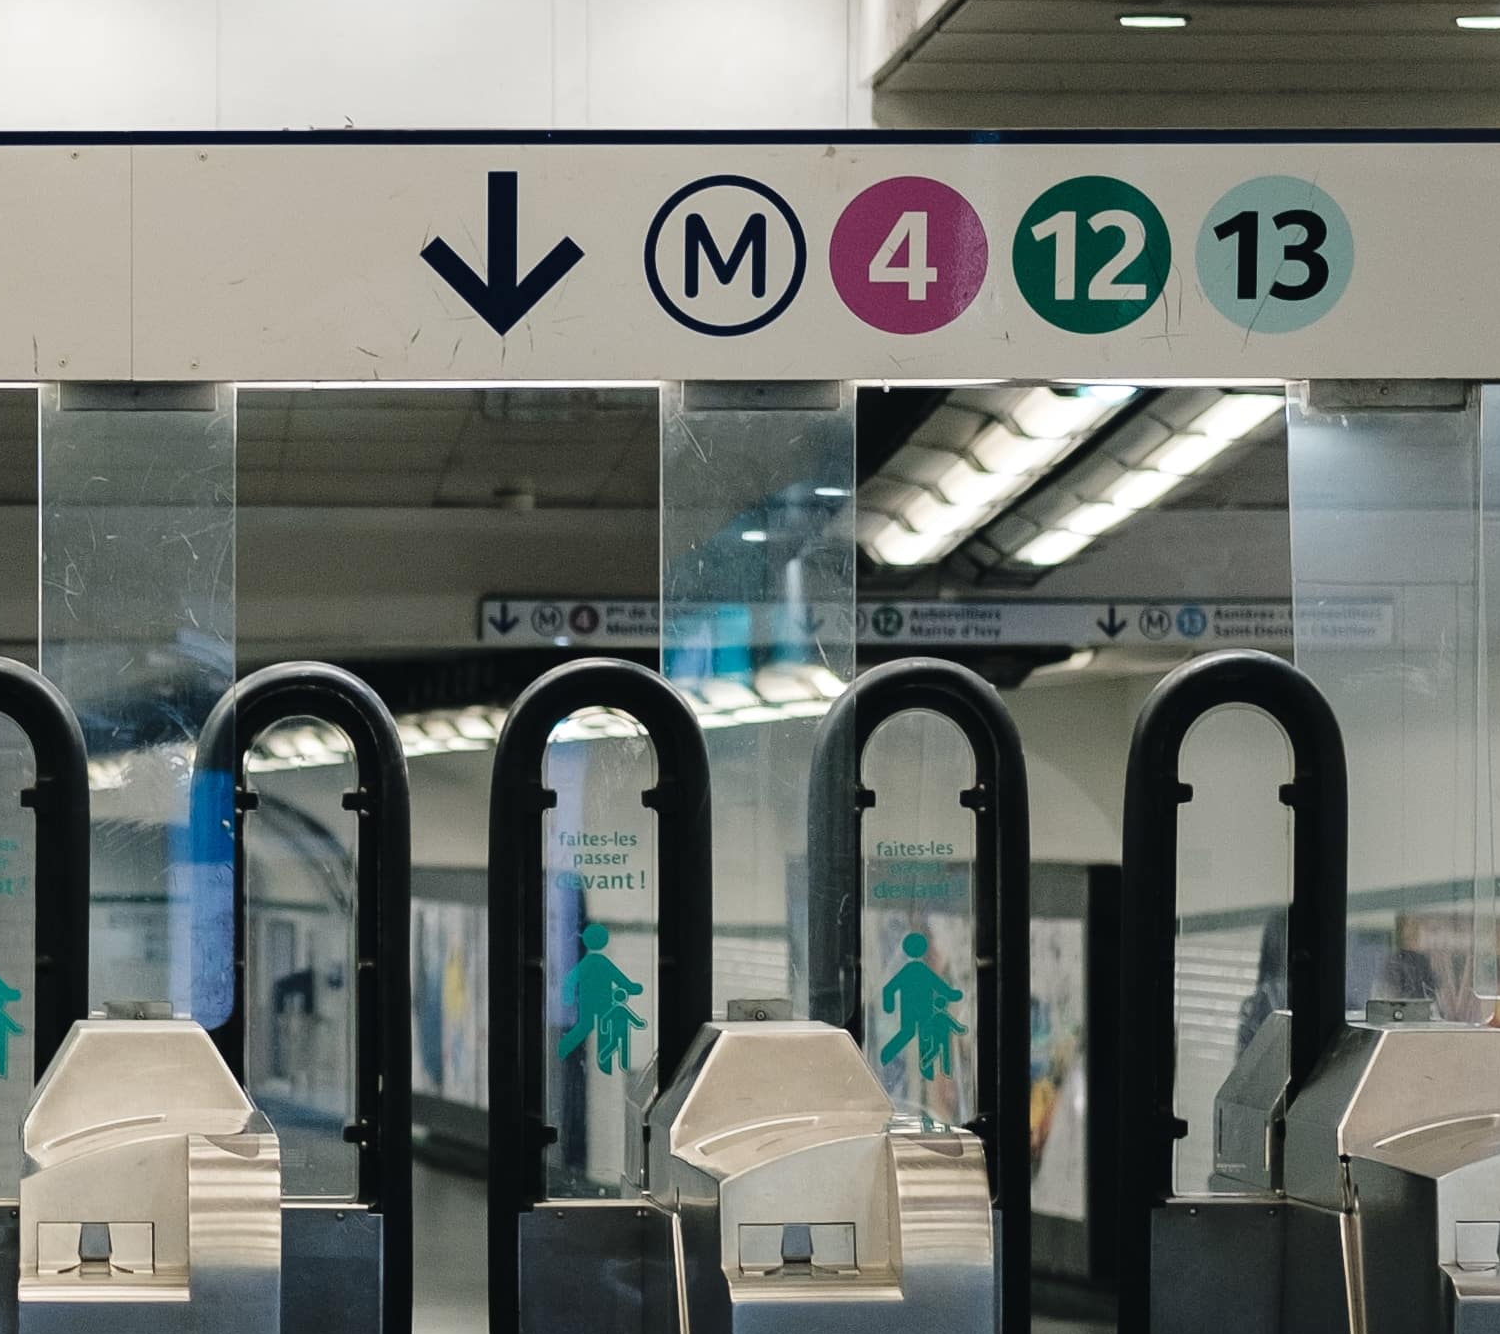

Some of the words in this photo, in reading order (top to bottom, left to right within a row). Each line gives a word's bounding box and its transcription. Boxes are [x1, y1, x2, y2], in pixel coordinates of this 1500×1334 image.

[684, 212, 767, 300] M
[866, 209, 940, 300] 4
[1029, 207, 1150, 302] 12
[1213, 207, 1329, 302] 13
[559, 831, 637, 846] faites-les
[877, 841, 953, 857] faites-les
[574, 853, 628, 867] passer
